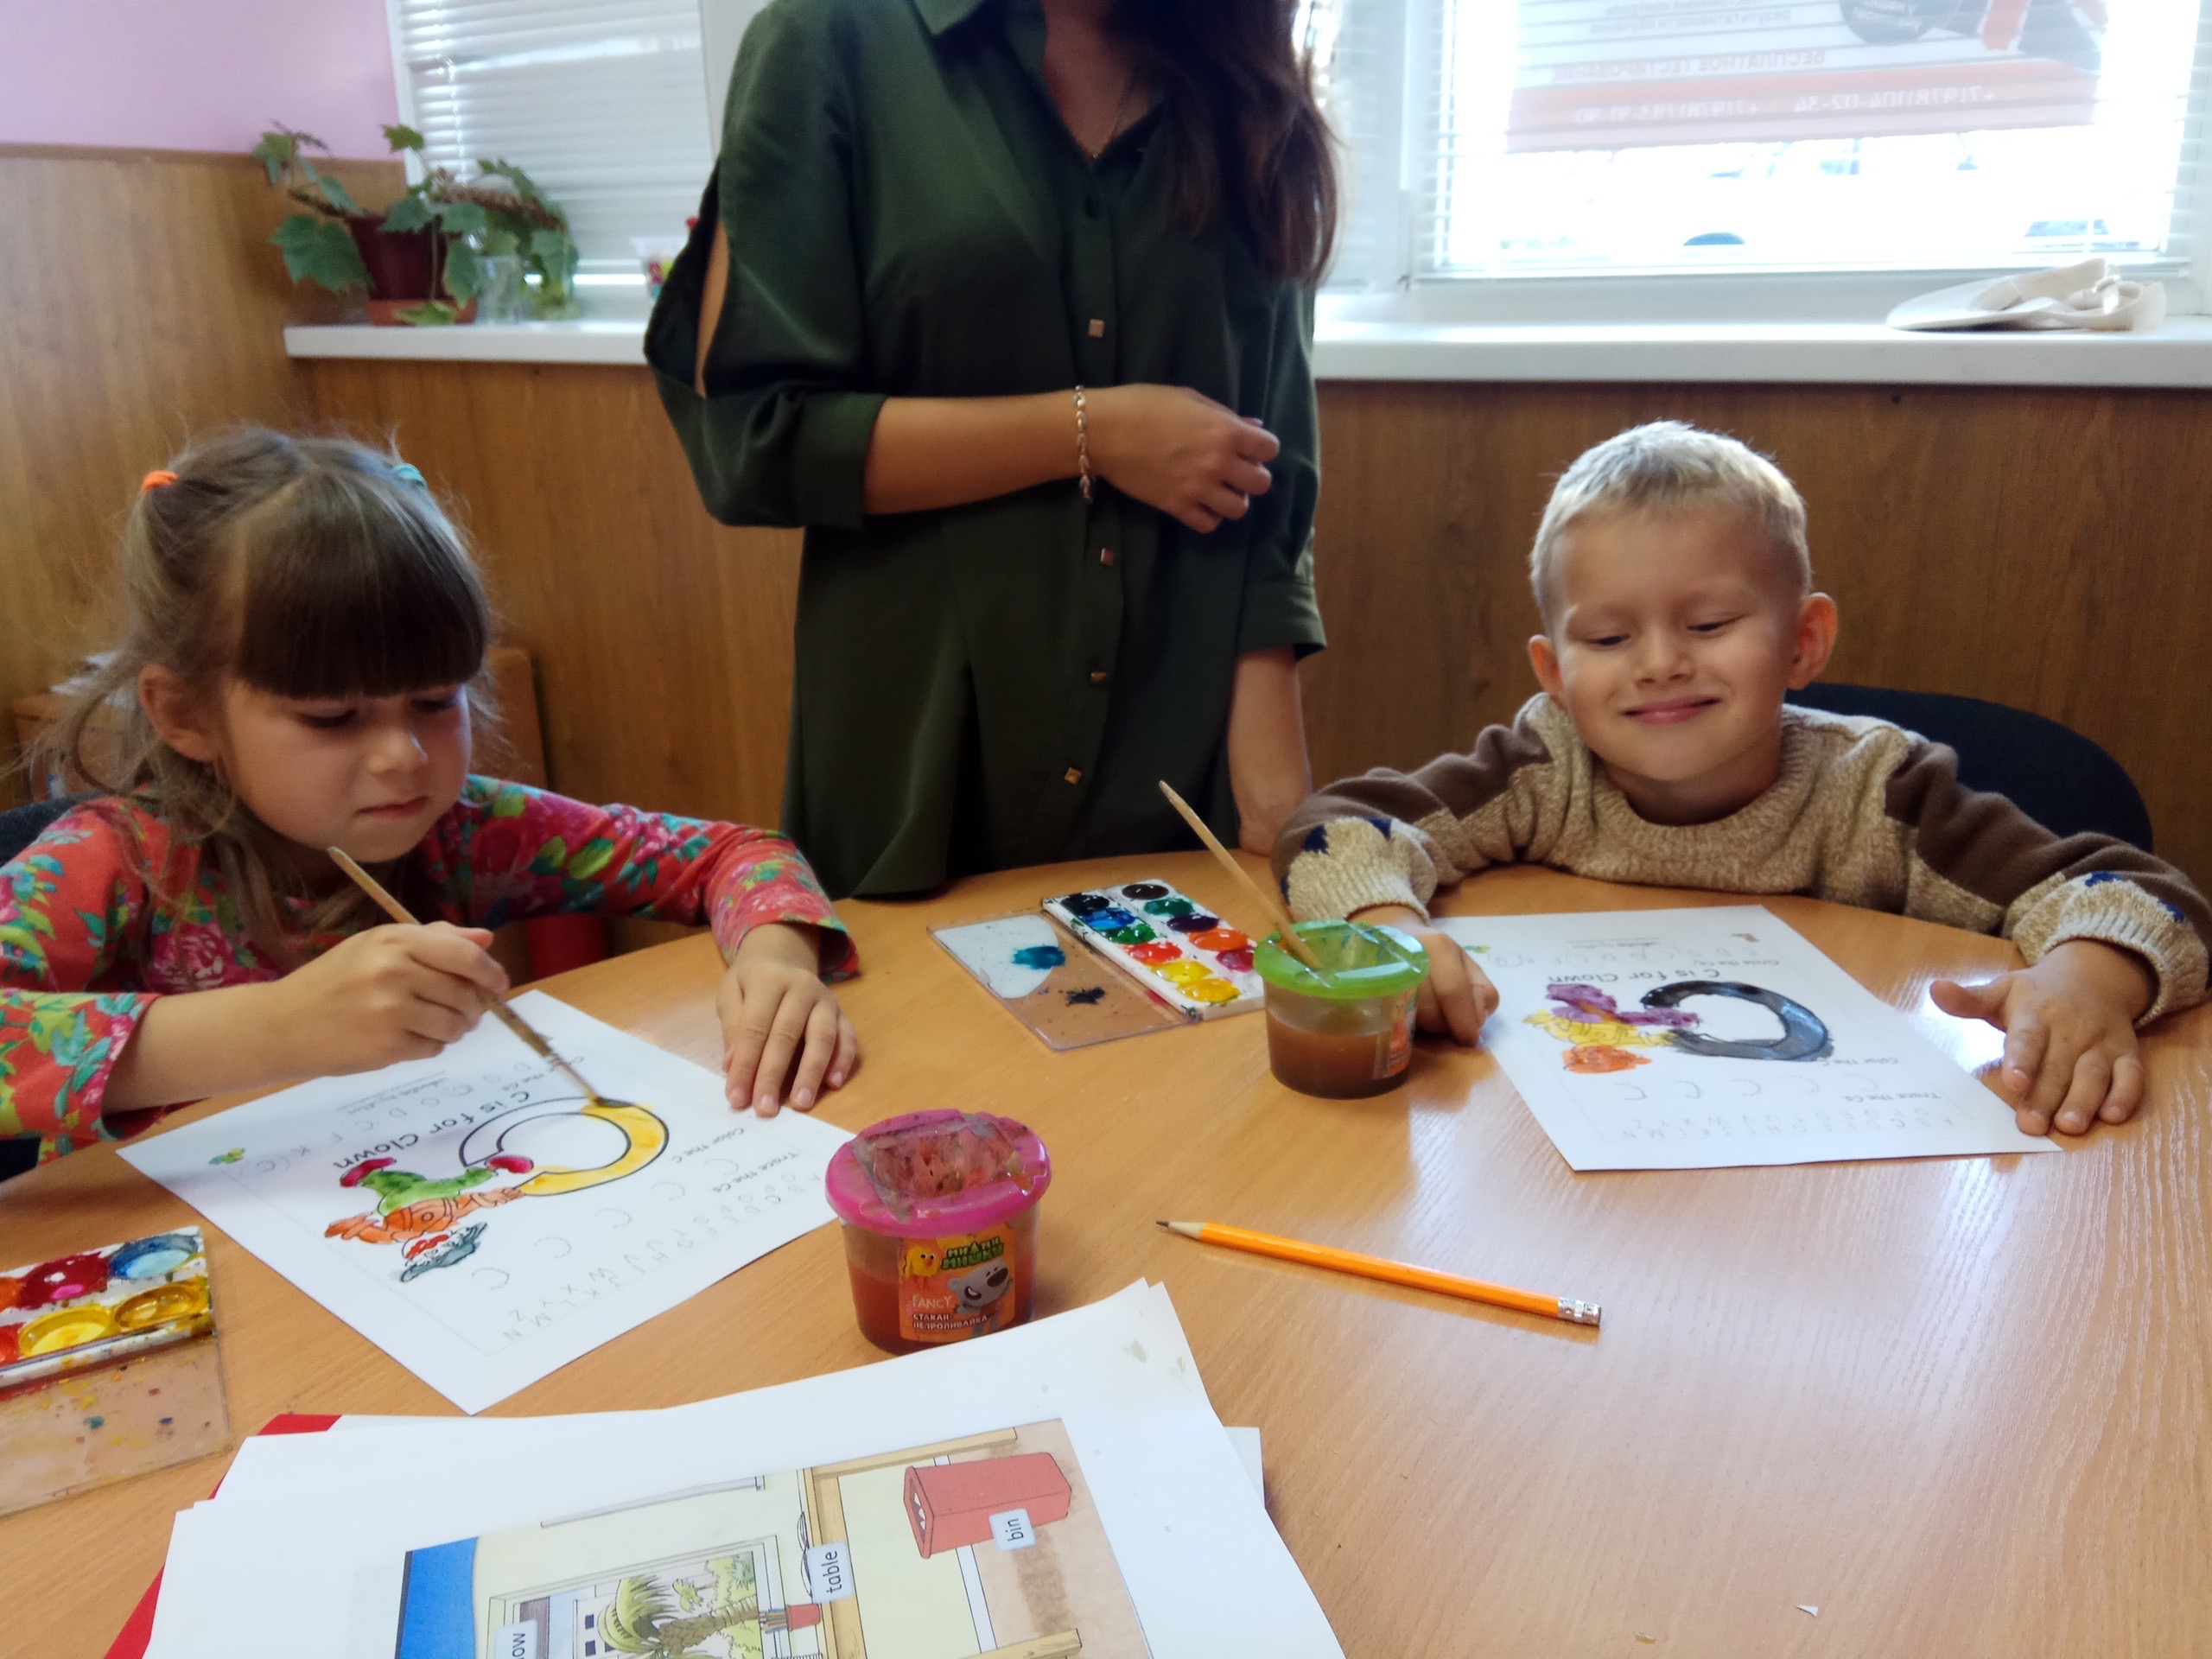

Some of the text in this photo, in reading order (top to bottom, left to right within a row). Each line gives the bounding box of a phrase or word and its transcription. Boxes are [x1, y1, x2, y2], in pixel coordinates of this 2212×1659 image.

[1548, 969, 1721, 983] C is for Clown
[1674, 1079, 1701, 1099] C
[333, 1090, 531, 1169] C is for Clown
[712, 1128, 745, 1145] Color
[683, 1144, 709, 1156] the
[758, 1152, 799, 1171] Trace
[732, 1171, 758, 1183] the
[594, 1208, 632, 1229] C
[534, 1236, 572, 1259] C
[471, 1267, 511, 1290] C
[912, 1294, 951, 1309] FANCY
[1004, 1516, 1025, 1542] bin
[821, 1550, 843, 1594] table
